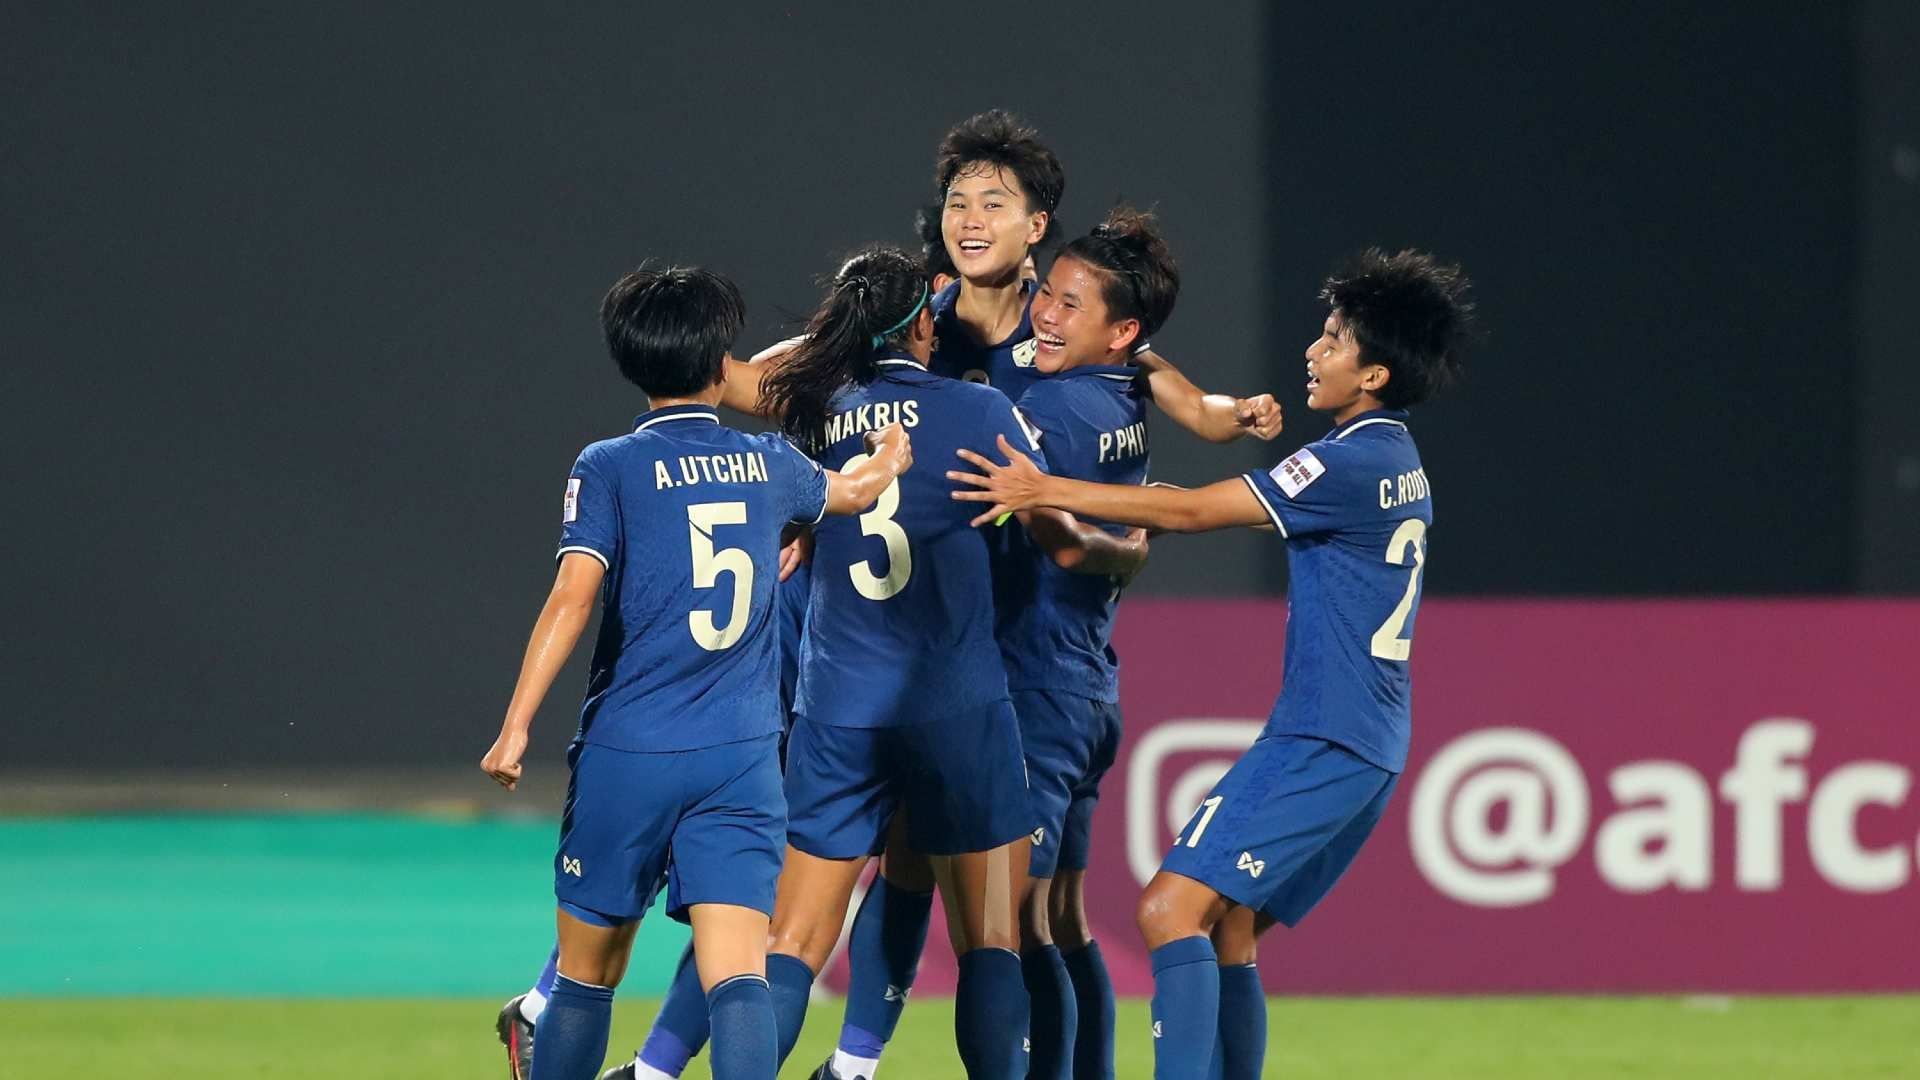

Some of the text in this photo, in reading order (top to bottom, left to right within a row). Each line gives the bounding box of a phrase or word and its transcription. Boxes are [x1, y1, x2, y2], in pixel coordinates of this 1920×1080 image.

[811, 400, 919, 454] .MAKRIS
[1099, 421, 1146, 463] P.PHI
[654, 452, 768, 490] A.UTCHAI
[849, 453, 912, 600] 3
[687, 501, 754, 652] 5
[1173, 795, 1223, 848] 1
[1408, 717, 1920, 908] @afc
